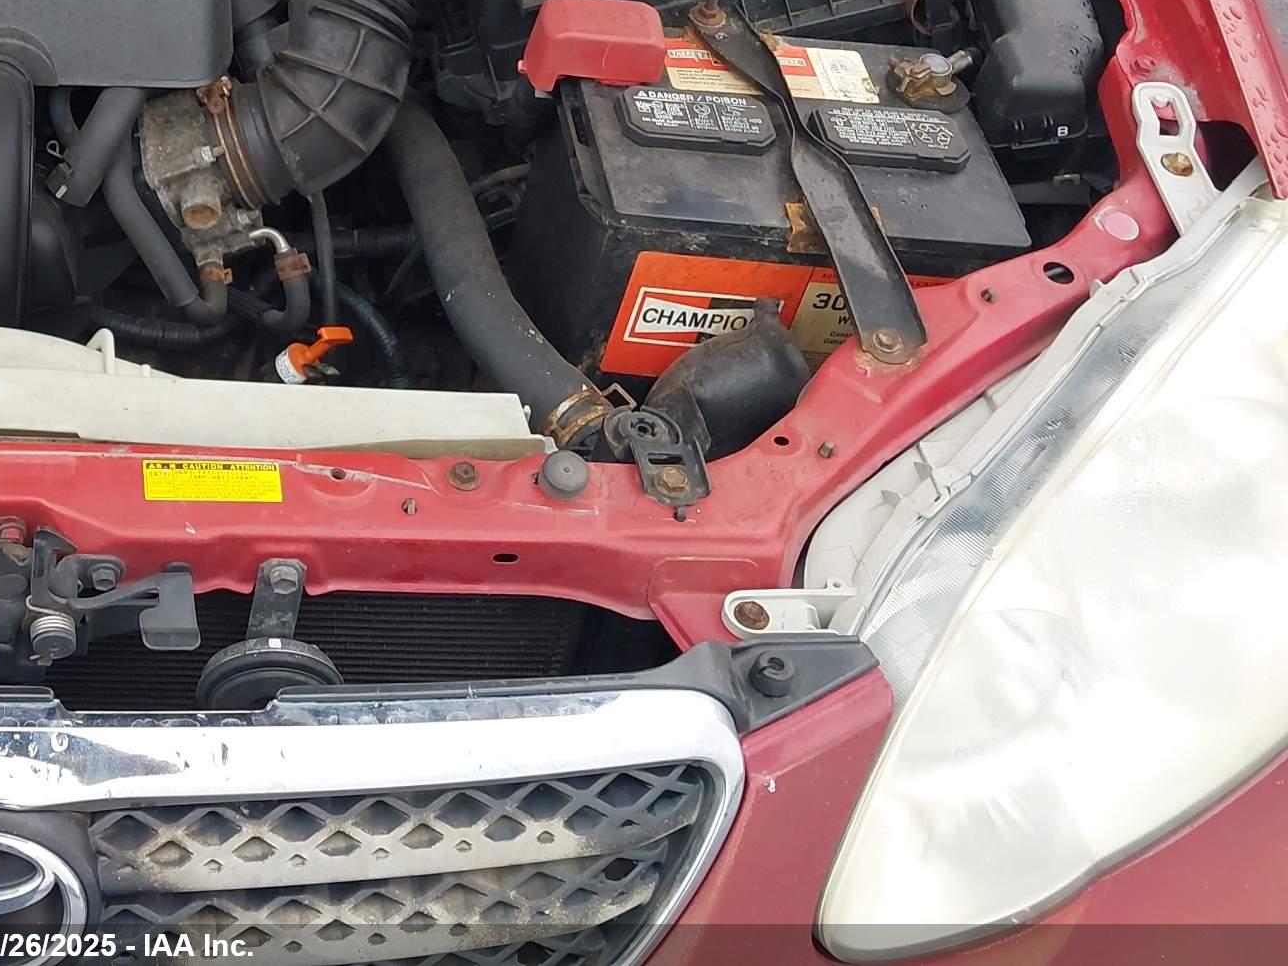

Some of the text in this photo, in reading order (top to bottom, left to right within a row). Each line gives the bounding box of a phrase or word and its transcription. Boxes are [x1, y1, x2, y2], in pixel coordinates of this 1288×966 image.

[648, 90, 694, 102] DANGER
[642, 308, 755, 331] CHAMPIO
[182, 462, 224, 471] CAUTION
[229, 463, 275, 472] ATTENTION
